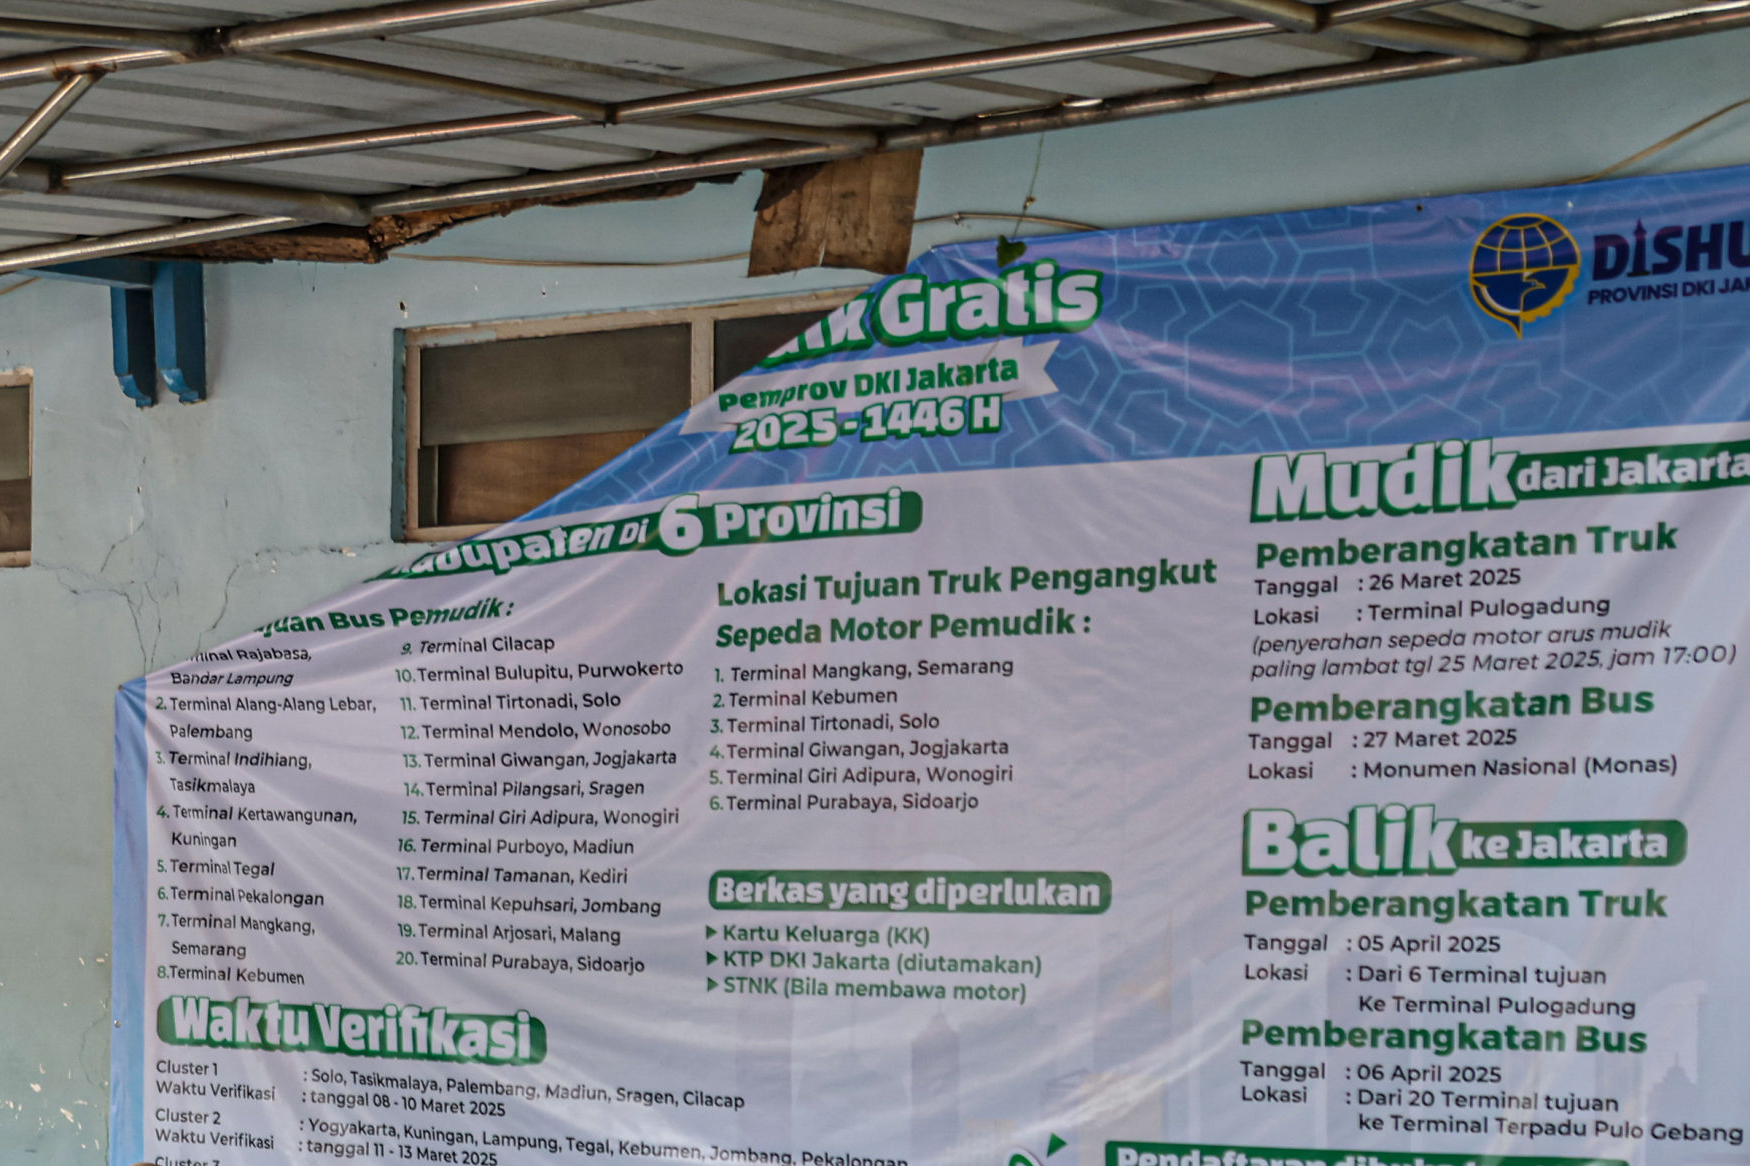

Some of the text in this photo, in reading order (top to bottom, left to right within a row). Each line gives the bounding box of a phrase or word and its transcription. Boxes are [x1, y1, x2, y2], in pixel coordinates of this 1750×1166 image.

[876, 262, 1100, 340] Gratis
[1587, 283, 1678, 305] PROVINSI
[1682, 279, 1715, 297] DKI
[719, 357, 1019, 412] Pemprov DKI Jakarta
[733, 408, 838, 450] 2025
[863, 398, 966, 438] 1446
[1254, 440, 1750, 518] Mudik dari Jakarta
[619, 517, 649, 545] Di
[658, 495, 704, 552] 6
[714, 488, 903, 540] Provinsi
[1257, 522, 1678, 568] Pemberangkatan Truk
[718, 558, 1217, 606] Lokasi Tujuan Truk Pengangkut
[1254, 568, 1520, 598] Tanggal 26 Maret 2025
[1254, 596, 1610, 625] Lokasi Terminal Pulogadung
[716, 608, 1074, 652] Sepeda Motor Pemudik
[421, 638, 487, 653] Terminal
[492, 636, 554, 653] Cilacap
[170, 672, 294, 687] Bandar Lampung
[731, 664, 806, 682] Terminal
[813, 662, 912, 681] Mangkang,
[918, 660, 1013, 676] Semarang
[170, 697, 231, 711] Terminal
[236, 697, 325, 714] Alang-Alang
[329, 697, 376, 712] Lebar,
[1251, 687, 1654, 726] Pemberangkatan Bus
[170, 724, 252, 742] Palembang
[1248, 728, 1516, 753] Tanggal 27 Maret 2025
[403, 750, 676, 770] 13. Terminal Giwangan, Jogjakarta
[1249, 755, 1677, 779] Lokasi Monumen Nasional (Monas)
[172, 804, 233, 820] Terminal
[238, 808, 357, 825] Kertawangunan,
[1249, 804, 1668, 871] Balik ke Jakarta
[716, 876, 1100, 910] Berkas yang diperlukan
[1246, 888, 1666, 924] Pemberangkatan Truk
[724, 925, 929, 948] Kartu Keluarga (KK)
[1244, 934, 1500, 956] Tanggal 05 April 2025
[396, 951, 645, 976] 20. Terminal Purabaya, Sidoarjo
[724, 950, 1041, 978] KTP DKI Jakarta (diutamakan)
[1245, 964, 1308, 980] Lokasi
[1359, 965, 1401, 982] Dari
[1428, 966, 1527, 983] Terminal
[1534, 966, 1606, 987] tujuan
[724, 976, 1026, 1005] STNK (Bila membawa motor)
[1360, 996, 1635, 1020] Ke Terminal Pulogadung
[172, 997, 531, 1060] Waktu Verifikasi
[1242, 1020, 1646, 1056] Pemberangkatan Bus
[156, 1060, 209, 1075] Cluster
[1240, 1061, 1501, 1085] Tanggal 06 April 2025
[156, 1080, 275, 1100] Waktu Verifikasi
[311, 1091, 368, 1108] tanggal
[373, 1094, 390, 1108] 08
[402, 1096, 416, 1110] 10
[421, 1098, 464, 1114] Maret
[470, 1101, 505, 1116] 2025
[312, 1068, 744, 1111] Solo, Tasikmalaya, Palembang, Madiun, Sragen, Cilacap
[1242, 1086, 1618, 1114] Lokasi Dari 20 Terminal tujuan
[1359, 1114, 1743, 1145] ke Terminal Terpadu Pulo Gebang
